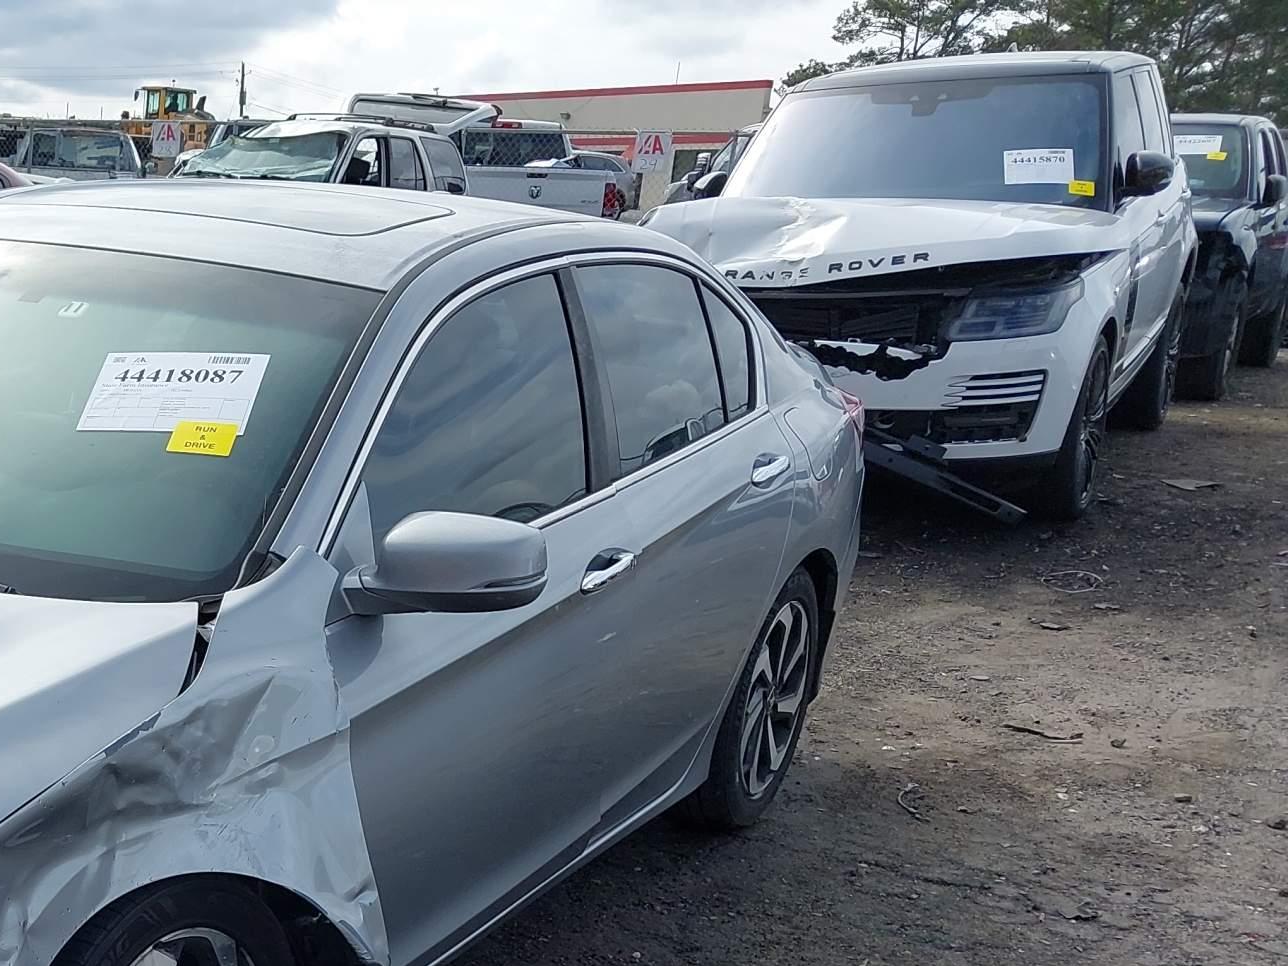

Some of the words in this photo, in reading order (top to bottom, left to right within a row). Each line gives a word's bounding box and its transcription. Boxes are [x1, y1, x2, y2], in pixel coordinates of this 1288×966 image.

[1011, 156, 1065, 164] 44415870
[827, 252, 931, 274] ROVER
[114, 368, 244, 384] 44418087
[194, 425, 217, 433] RUN
[184, 440, 216, 450] DRIVE
